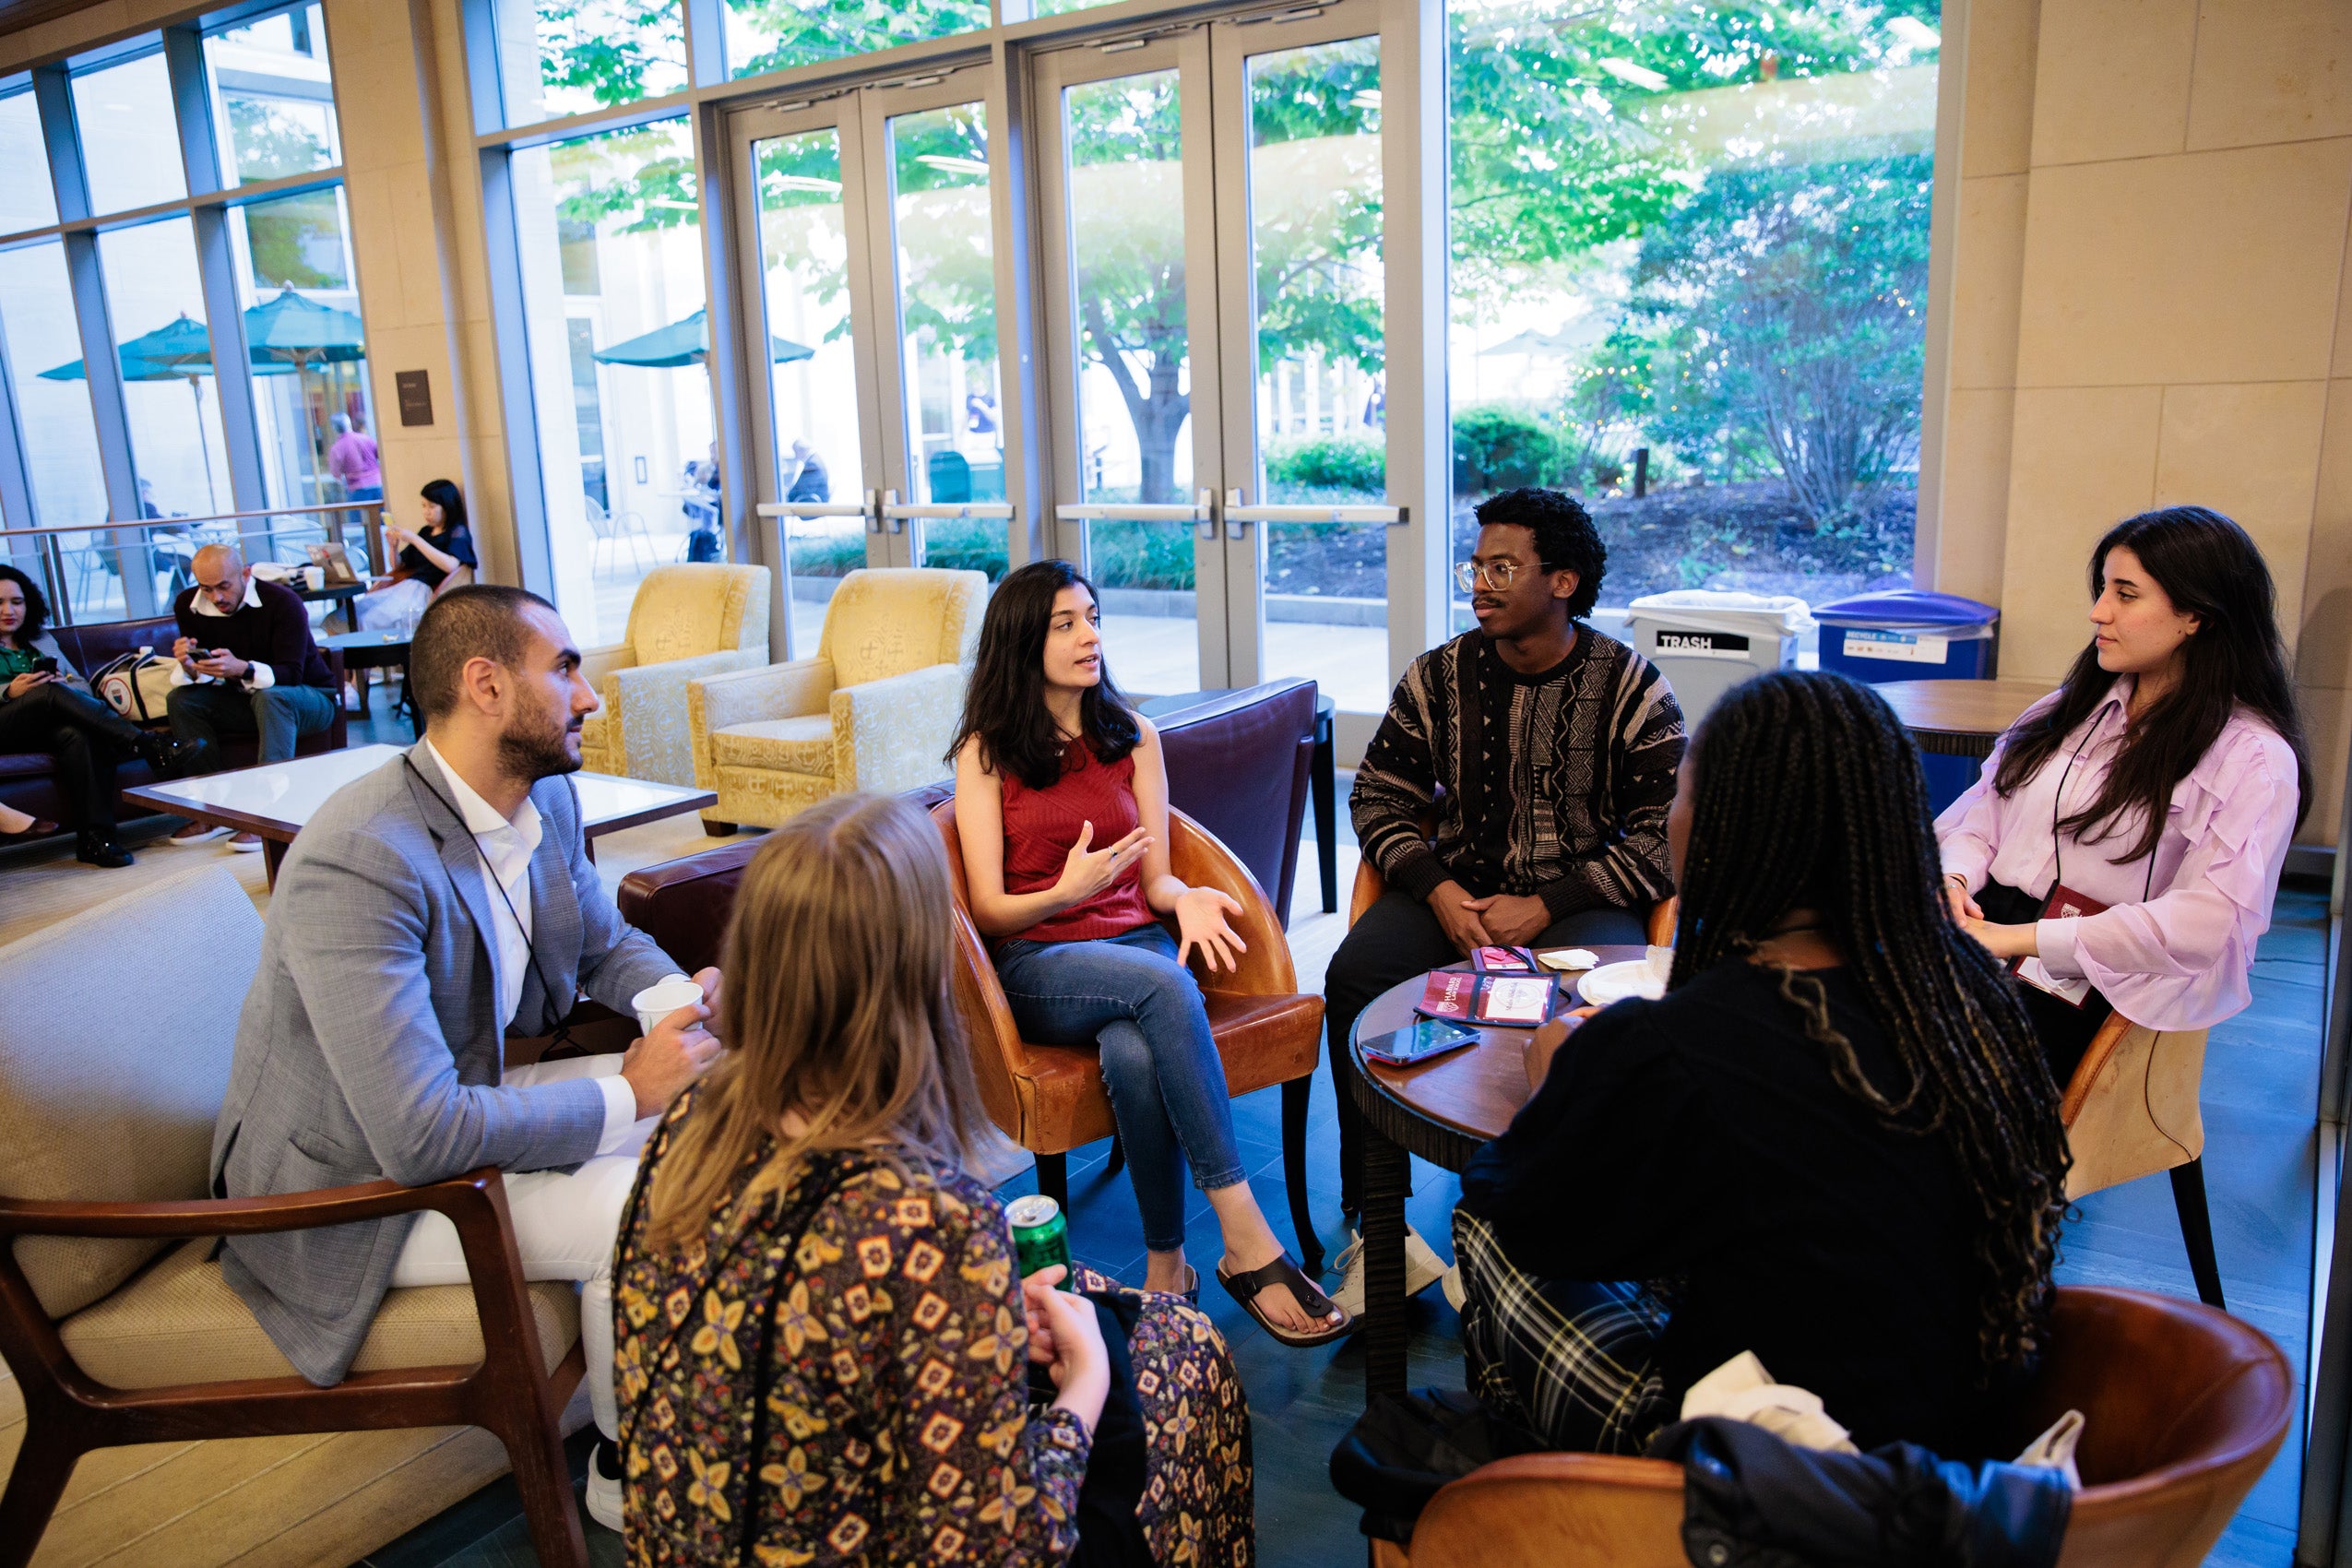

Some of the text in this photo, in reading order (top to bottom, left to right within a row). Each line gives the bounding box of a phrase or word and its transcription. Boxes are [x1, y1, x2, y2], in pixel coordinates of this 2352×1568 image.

[1661, 635, 1712, 649] TRASH
[1846, 631, 1876, 640] RECYCLE
[1444, 977, 1456, 1002] HARVARD
